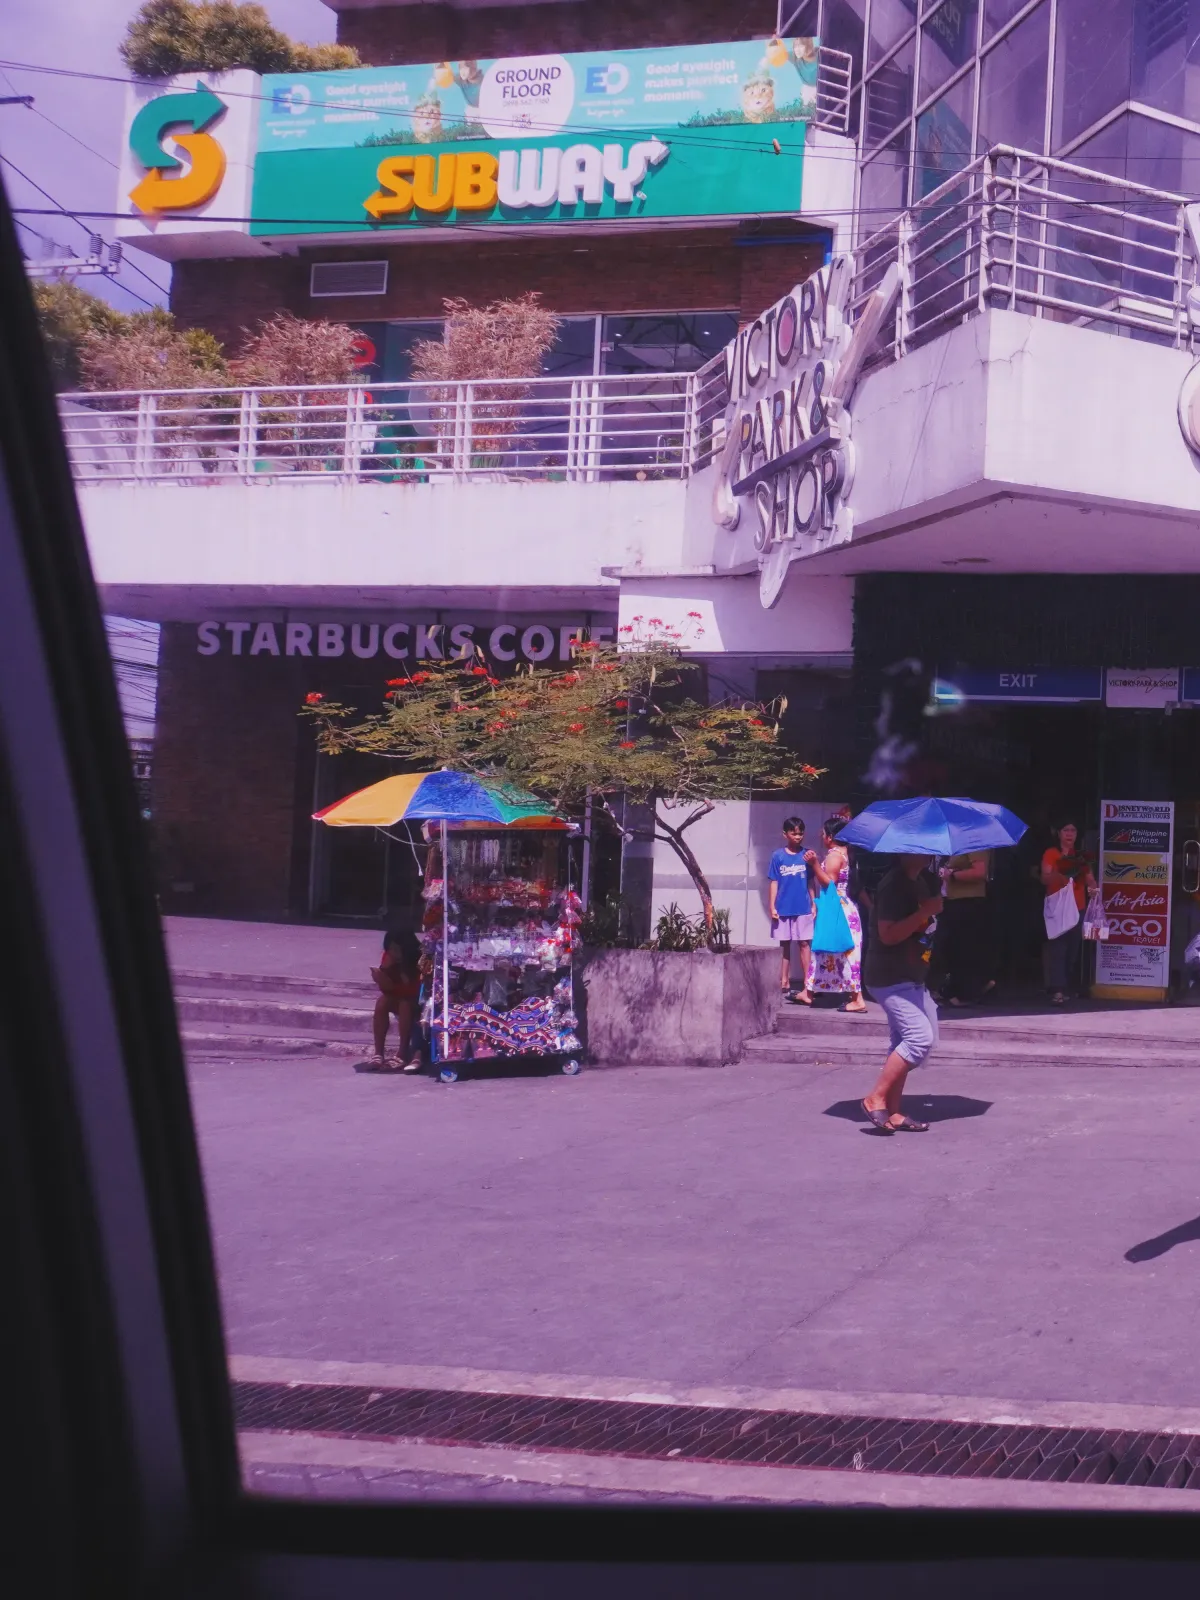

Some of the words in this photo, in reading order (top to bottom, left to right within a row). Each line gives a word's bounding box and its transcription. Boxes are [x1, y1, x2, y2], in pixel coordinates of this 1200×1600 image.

[495, 66, 562, 84] GROUND
[646, 63, 680, 75] Good
[502, 83, 552, 98] FLOOR
[363, 138, 668, 219] SUBWAY
[725, 257, 840, 401] VICTORY
[738, 370, 810, 482] PARK
[809, 360, 832, 436] &
[754, 450, 845, 553] SHOP
[196, 620, 475, 659] STARBUCKS
[998, 673, 1038, 689] EXIT
[1136, 679, 1152, 687] PARK
[1131, 829, 1168, 838] Philippine
[1135, 872, 1167, 880] PACIFIC
[1108, 918, 1162, 936] 2GO
